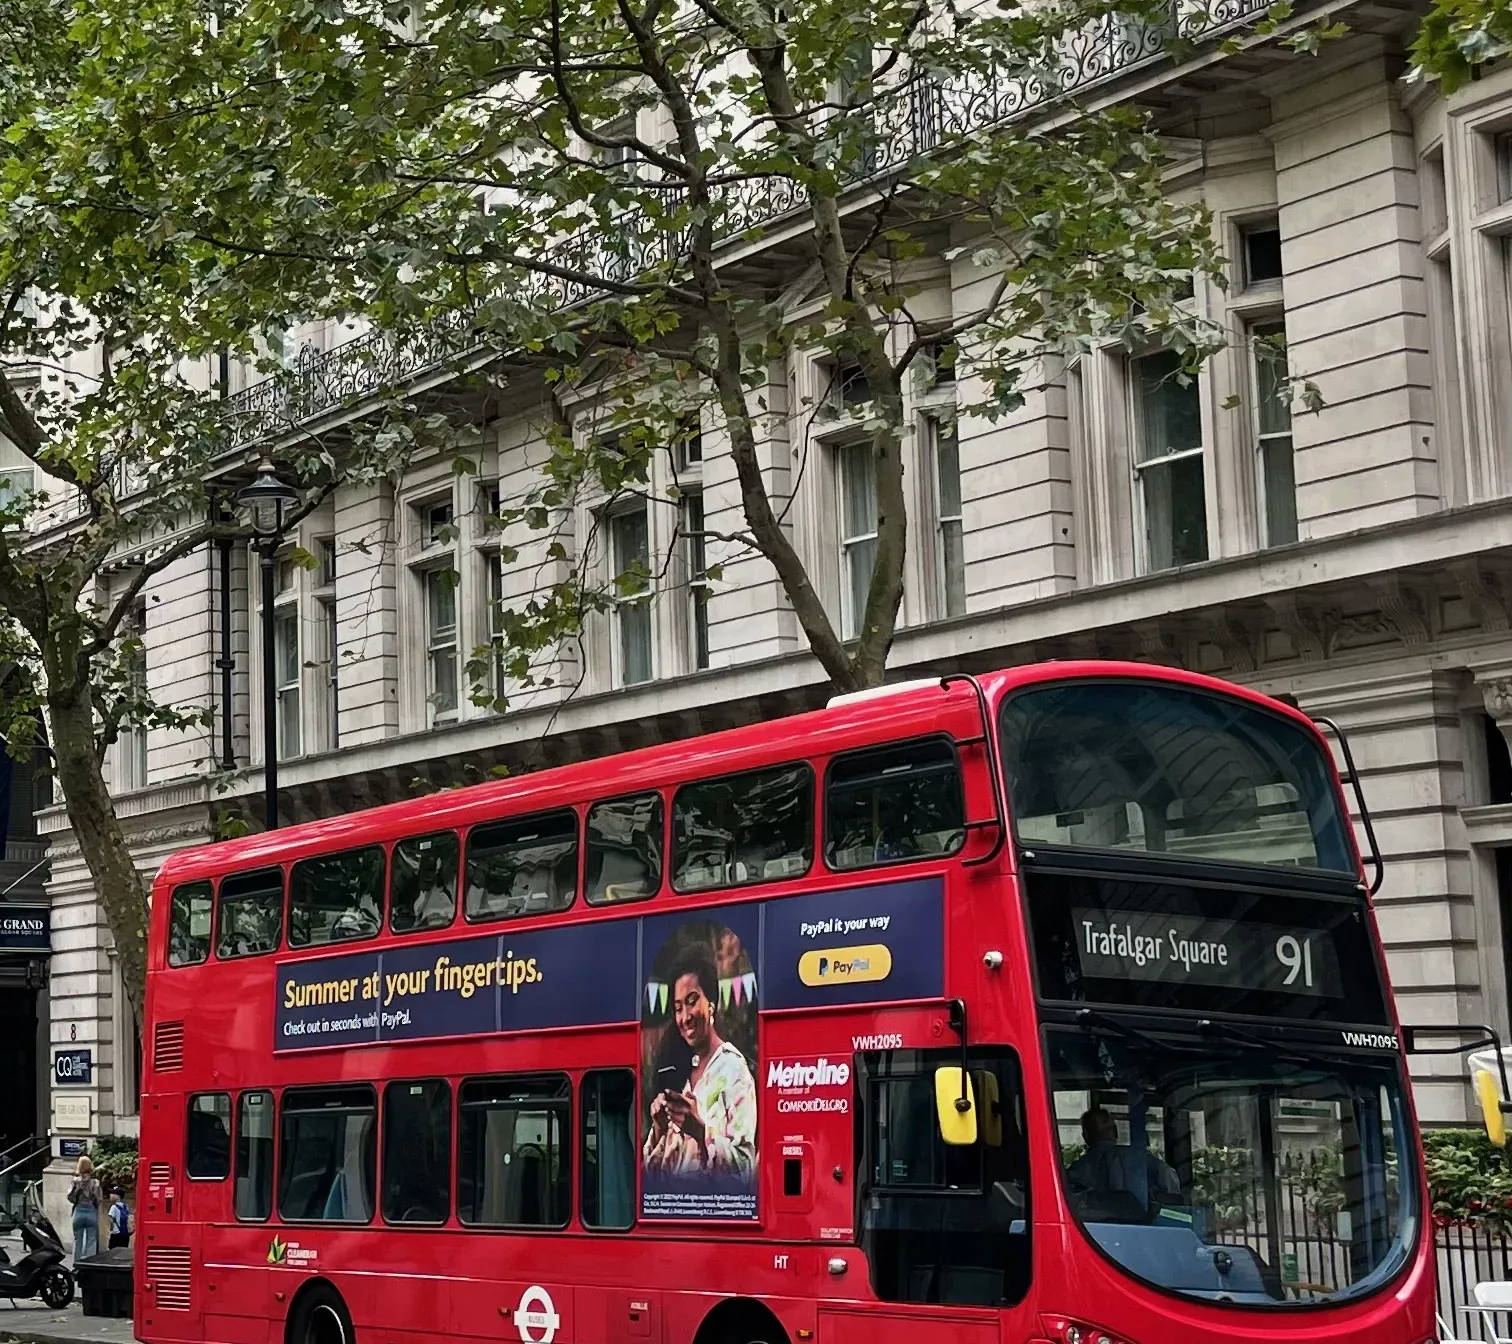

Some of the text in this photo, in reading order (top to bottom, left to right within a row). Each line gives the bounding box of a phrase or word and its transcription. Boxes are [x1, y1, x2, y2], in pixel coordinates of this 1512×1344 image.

[3, 919, 44, 930] GRAND
[800, 916, 890, 938] PayPal it your way
[1082, 921, 1228, 972] Trafalgar Square
[1276, 935, 1313, 986] 91
[284, 950, 543, 1008] Summer at your fingertips.
[284, 1009, 411, 1036] Check out in seconds with PayPal.
[852, 1034, 902, 1050] VWH2095
[1342, 1031, 1399, 1050] VWH2095
[56, 1056, 72, 1076] CQ
[766, 1058, 850, 1088] Metroline
[774, 1255, 788, 1269] HT
